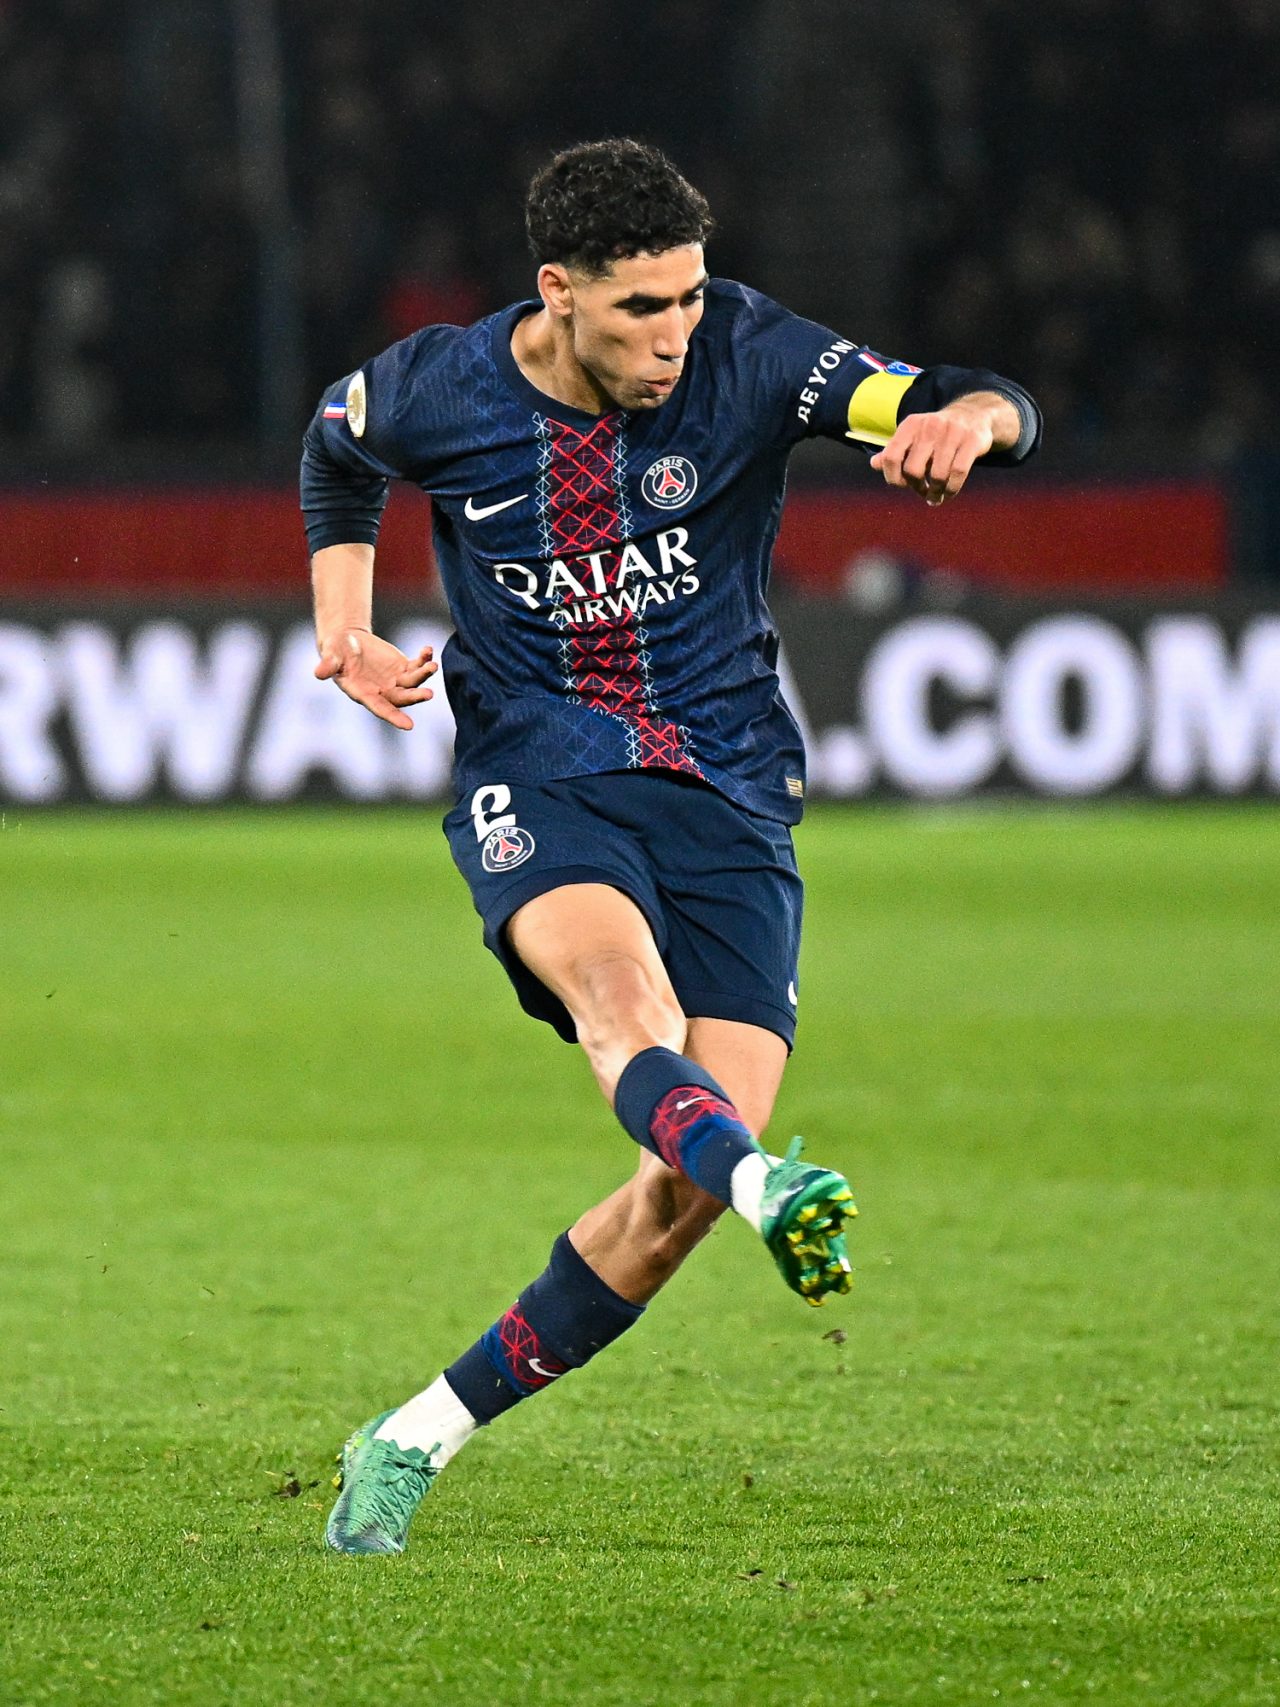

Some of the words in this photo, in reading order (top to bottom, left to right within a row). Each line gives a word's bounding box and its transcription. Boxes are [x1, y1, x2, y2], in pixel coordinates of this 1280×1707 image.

[798, 339, 859, 424] BEYON
[648, 458, 684, 476] PARIS
[493, 526, 698, 610] QATAR
[548, 567, 700, 623] AIRWAYS
